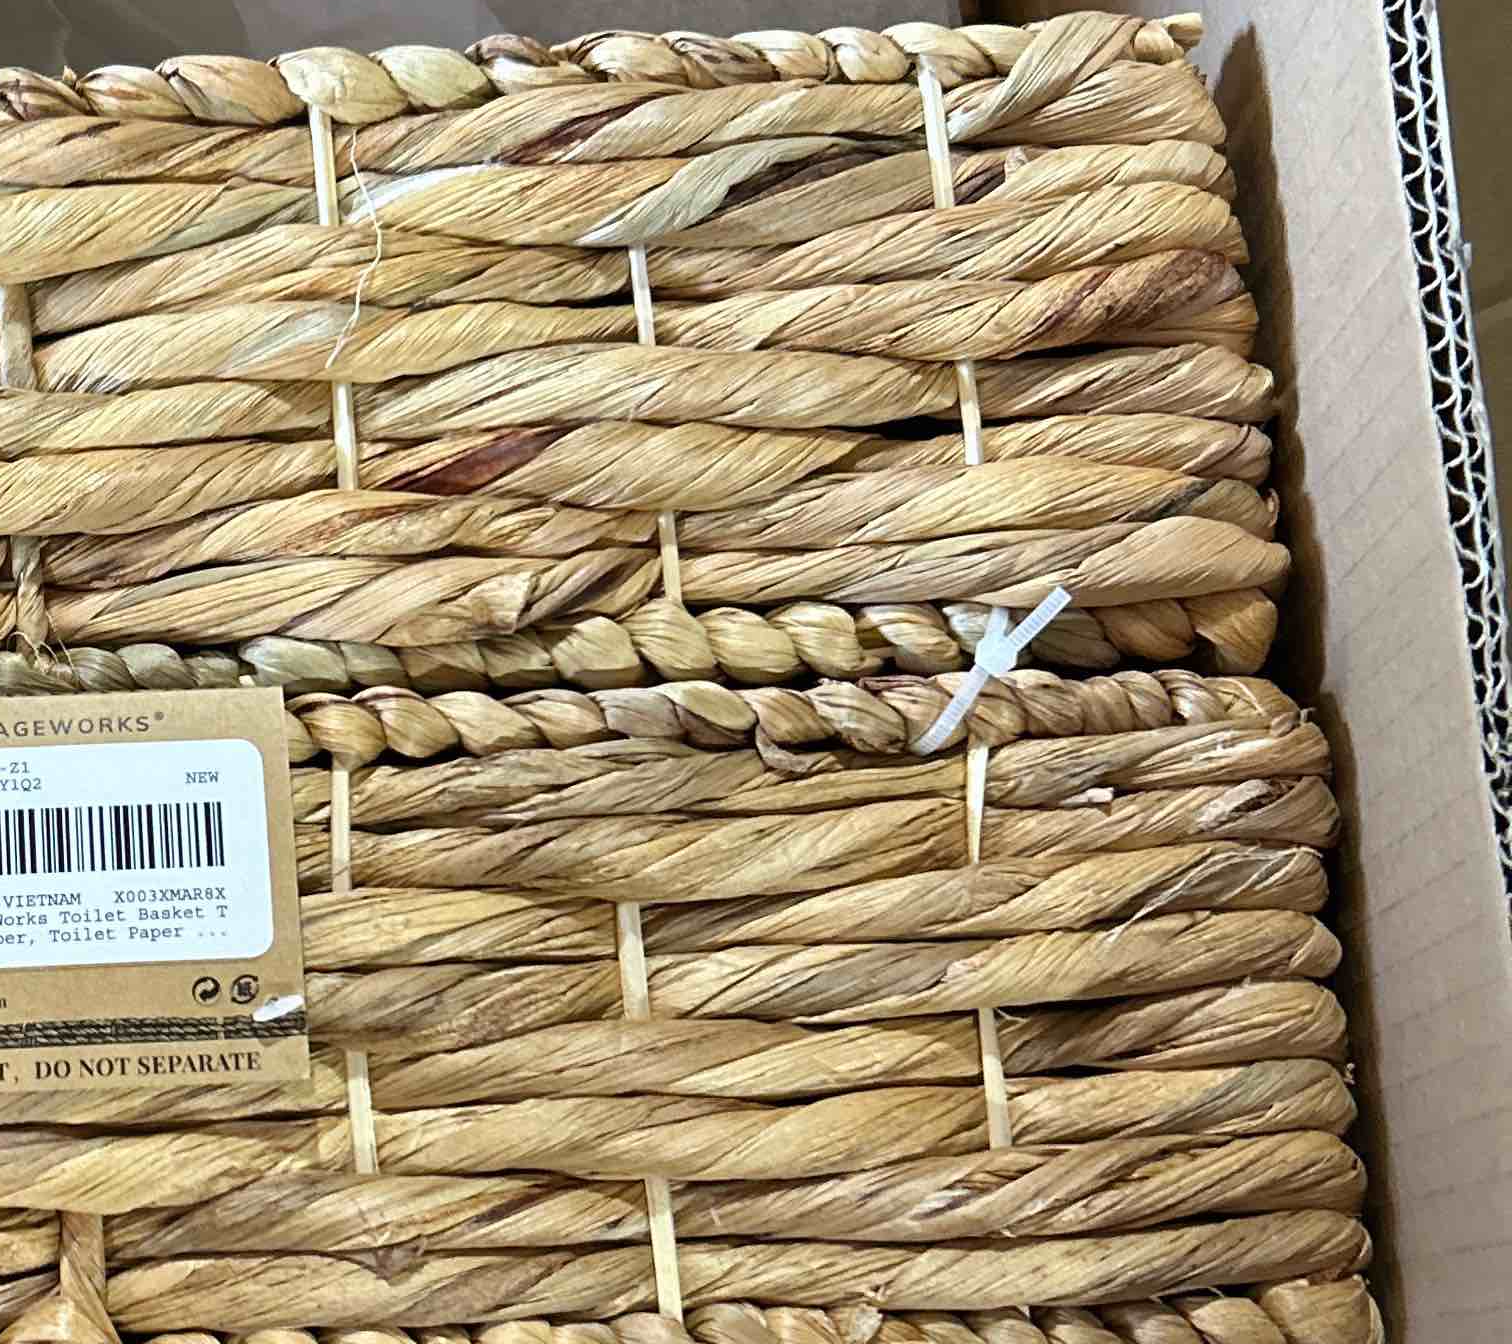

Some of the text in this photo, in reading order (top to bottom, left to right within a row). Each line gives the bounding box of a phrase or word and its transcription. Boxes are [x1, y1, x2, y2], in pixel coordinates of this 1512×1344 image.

[185, 770, 220, 785] NEW
[3, 892, 82, 908] VIETNAM
[113, 887, 227, 904] X003XMAR8X
[58, 908, 126, 925] Toilet
[138, 905, 206, 921] Basket
[216, 904, 228, 918] T
[48, 927, 117, 943] Toilet
[128, 926, 184, 942] Paper
[34, 1058, 72, 1080] DO
[78, 1056, 131, 1079] NOT
[136, 1050, 261, 1075] SEPARATE
